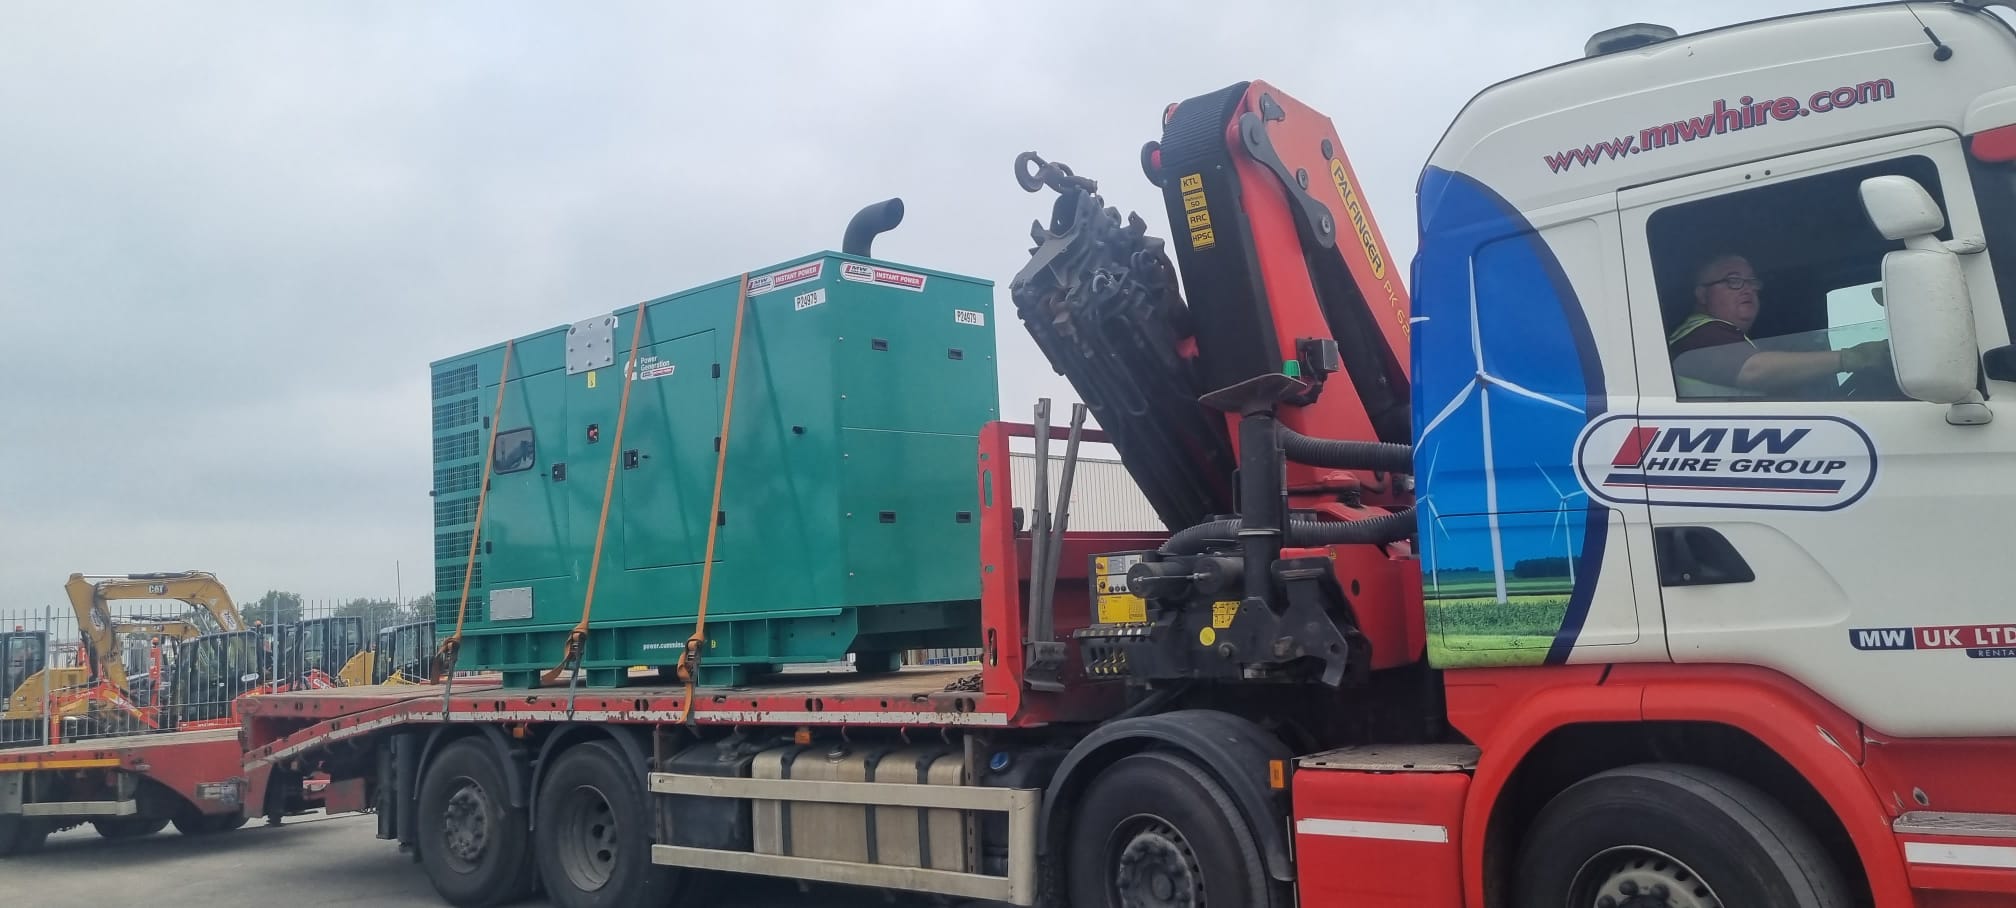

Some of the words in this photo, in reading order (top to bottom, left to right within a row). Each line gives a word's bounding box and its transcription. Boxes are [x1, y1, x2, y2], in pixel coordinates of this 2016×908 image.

[1544, 78, 1894, 173] www.mwhire.com
[1183, 177, 1198, 187] KTL
[1190, 214, 1208, 224] RRC
[1332, 166, 1383, 273] PALFINGER
[1192, 231, 1212, 242] HPSC
[775, 270, 797, 284] INSTANT
[797, 266, 817, 279] POWER
[876, 271, 899, 281] INSTANT
[900, 276, 921, 285] POWER
[797, 292, 817, 308] P24979
[957, 311, 977, 324] P24979
[1383, 279, 1398, 307] PK
[1397, 309, 1410, 342] 62
[641, 356, 657, 364] Power
[1655, 427, 1812, 454] MW
[1647, 458, 1720, 472] HIRE
[1729, 458, 1847, 475] GROUP
[148, 584, 164, 594] CAT
[1858, 629, 1906, 647] MW
[1922, 628, 1963, 647] UK
[1974, 627, 2016, 645] LTD
